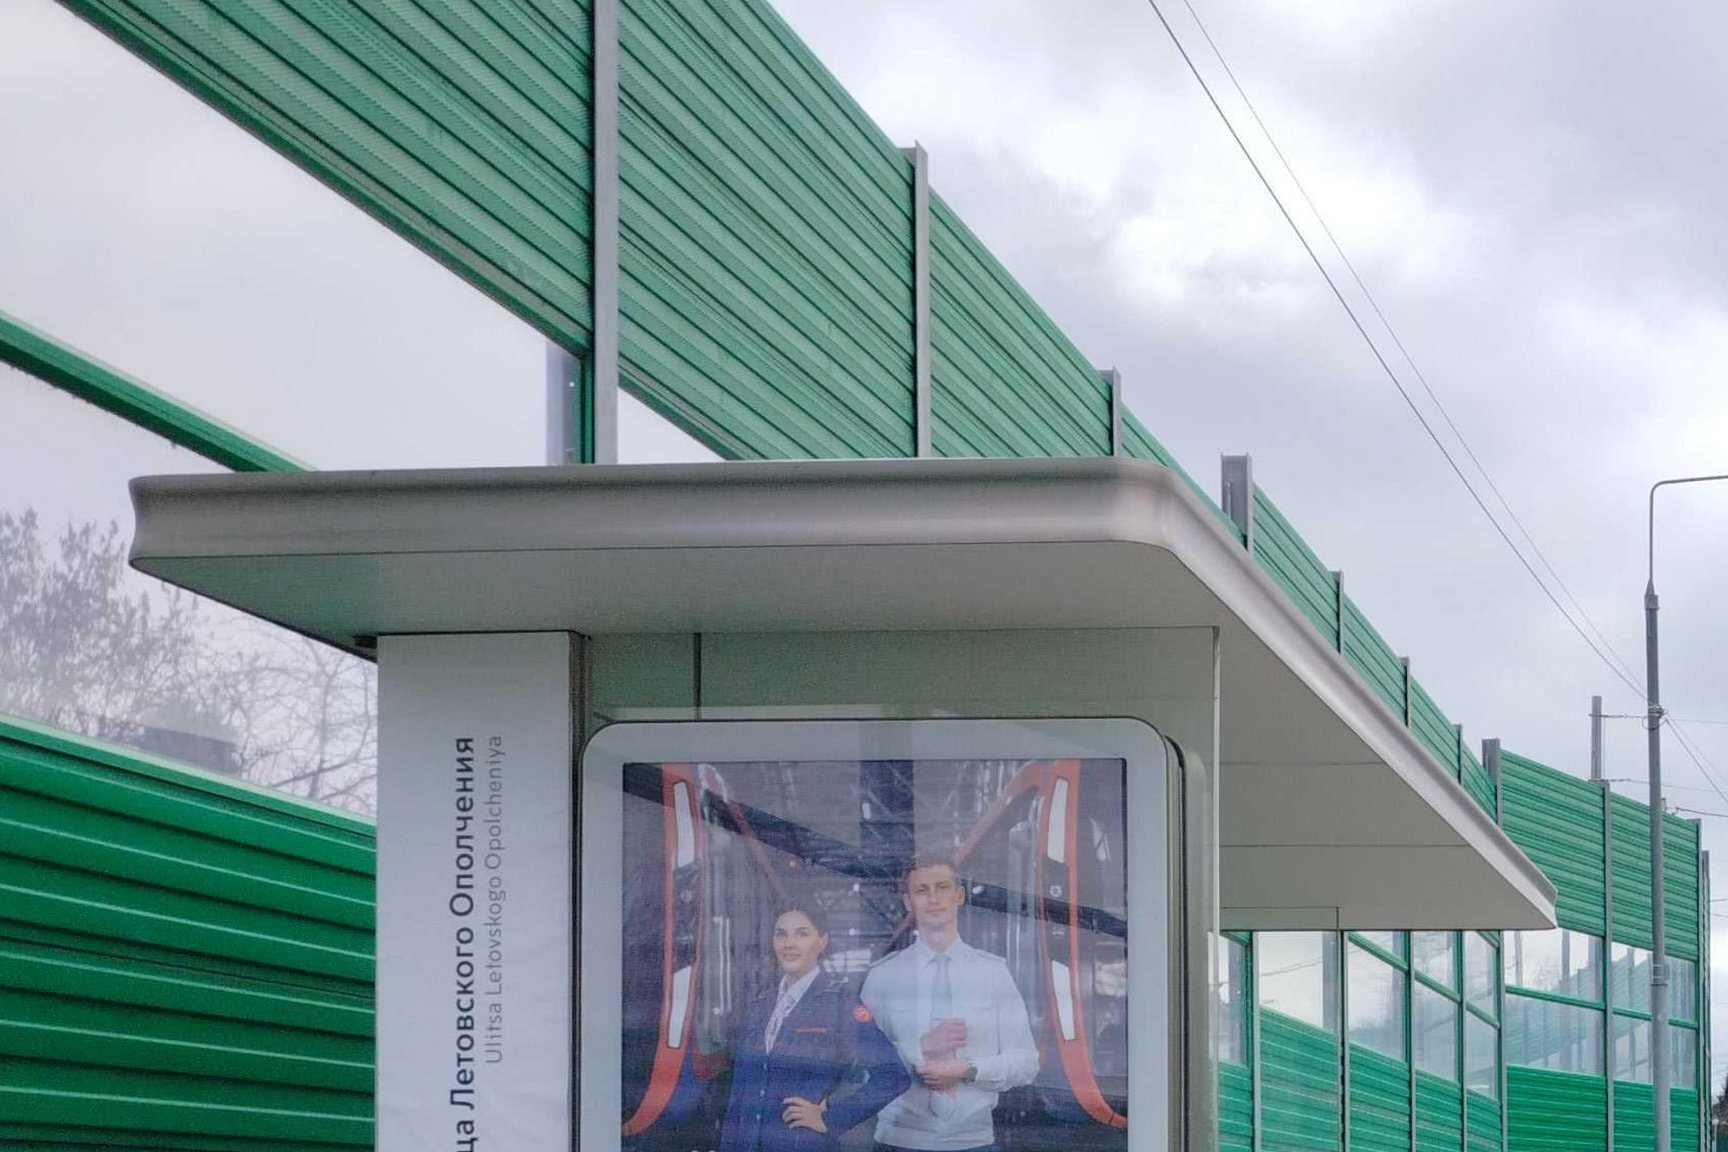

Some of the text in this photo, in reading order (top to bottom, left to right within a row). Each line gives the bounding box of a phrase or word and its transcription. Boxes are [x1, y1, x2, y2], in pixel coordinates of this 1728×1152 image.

[449, 736, 474, 918] Ополчения
[484, 734, 507, 1065] Ulitsa Letovskogo Opolcheniya
[449, 926, 474, 1111] Летовского
